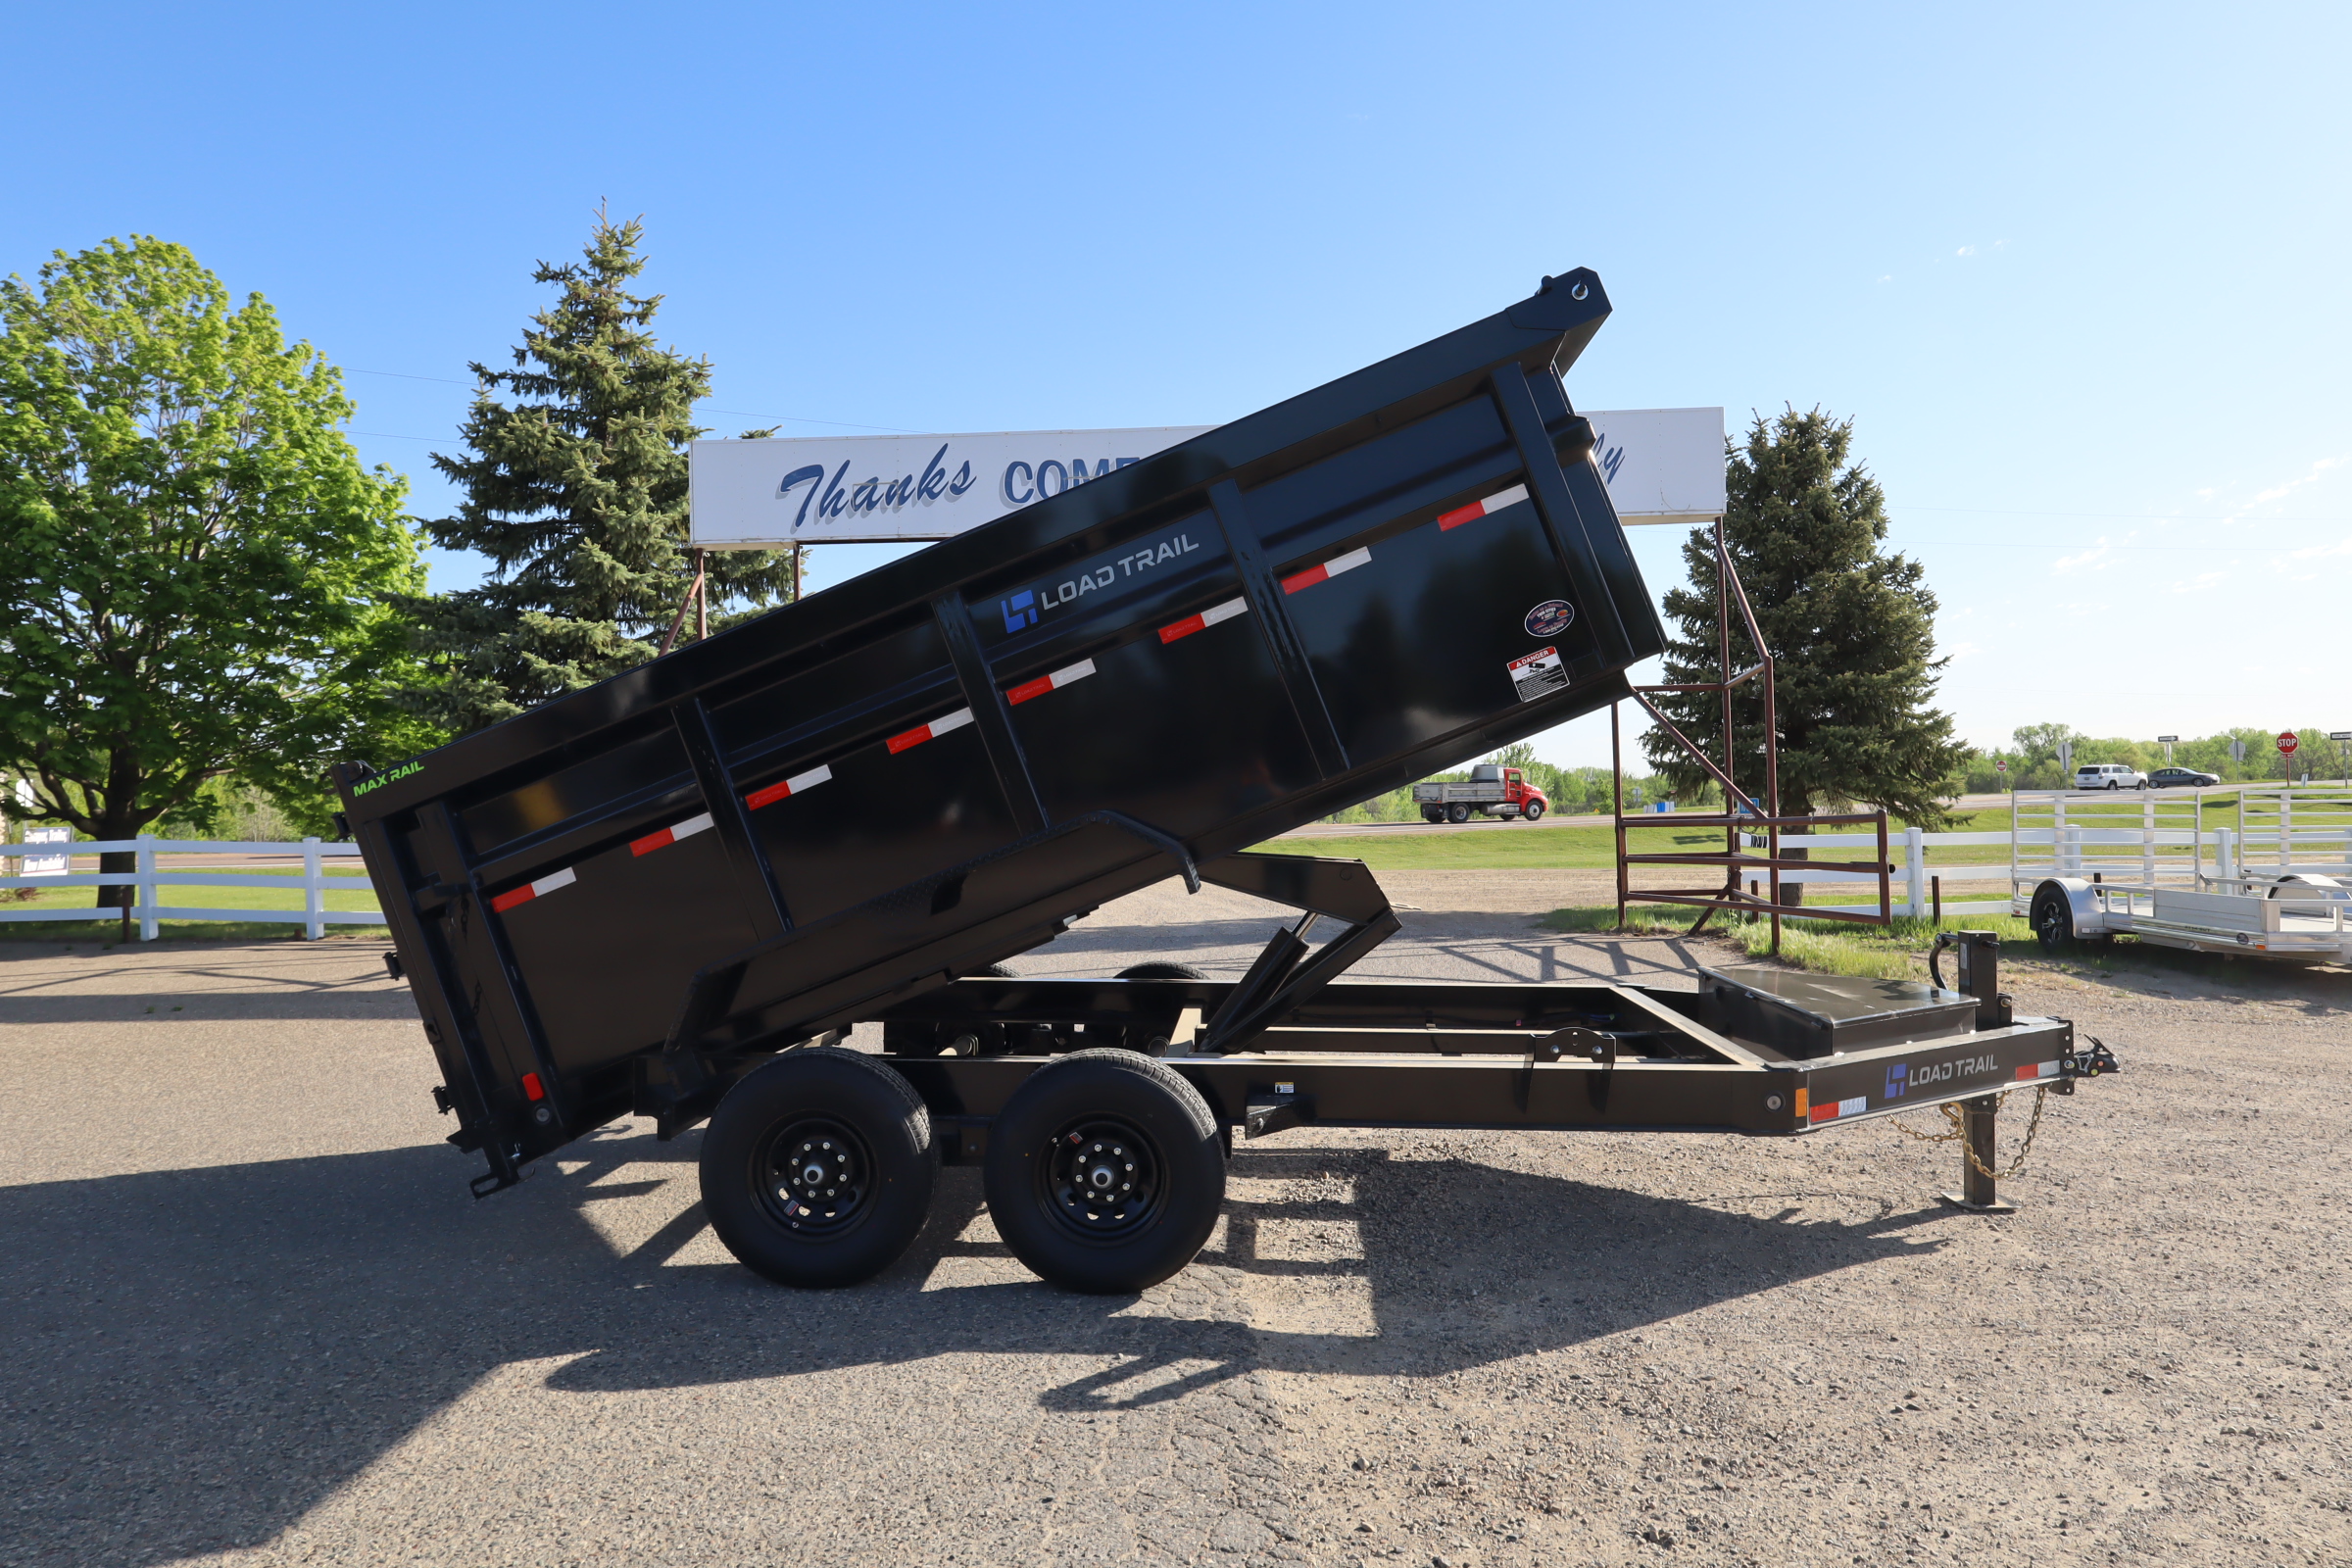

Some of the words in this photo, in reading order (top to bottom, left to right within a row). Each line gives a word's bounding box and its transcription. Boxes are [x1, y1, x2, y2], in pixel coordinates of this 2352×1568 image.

[780, 443, 977, 529] Thanks
[1004, 457, 1141, 504] COM
[1041, 564, 1115, 611] LOAD
[1118, 534, 1200, 576] TRAIL
[1521, 650, 1549, 665] DANGER
[2278, 738, 2297, 748] STOP
[353, 774, 388, 798] MAX
[389, 760, 425, 782] RAIL
[1909, 1061, 1953, 1087] LOAD
[1955, 1054, 1998, 1076] TRAIL
